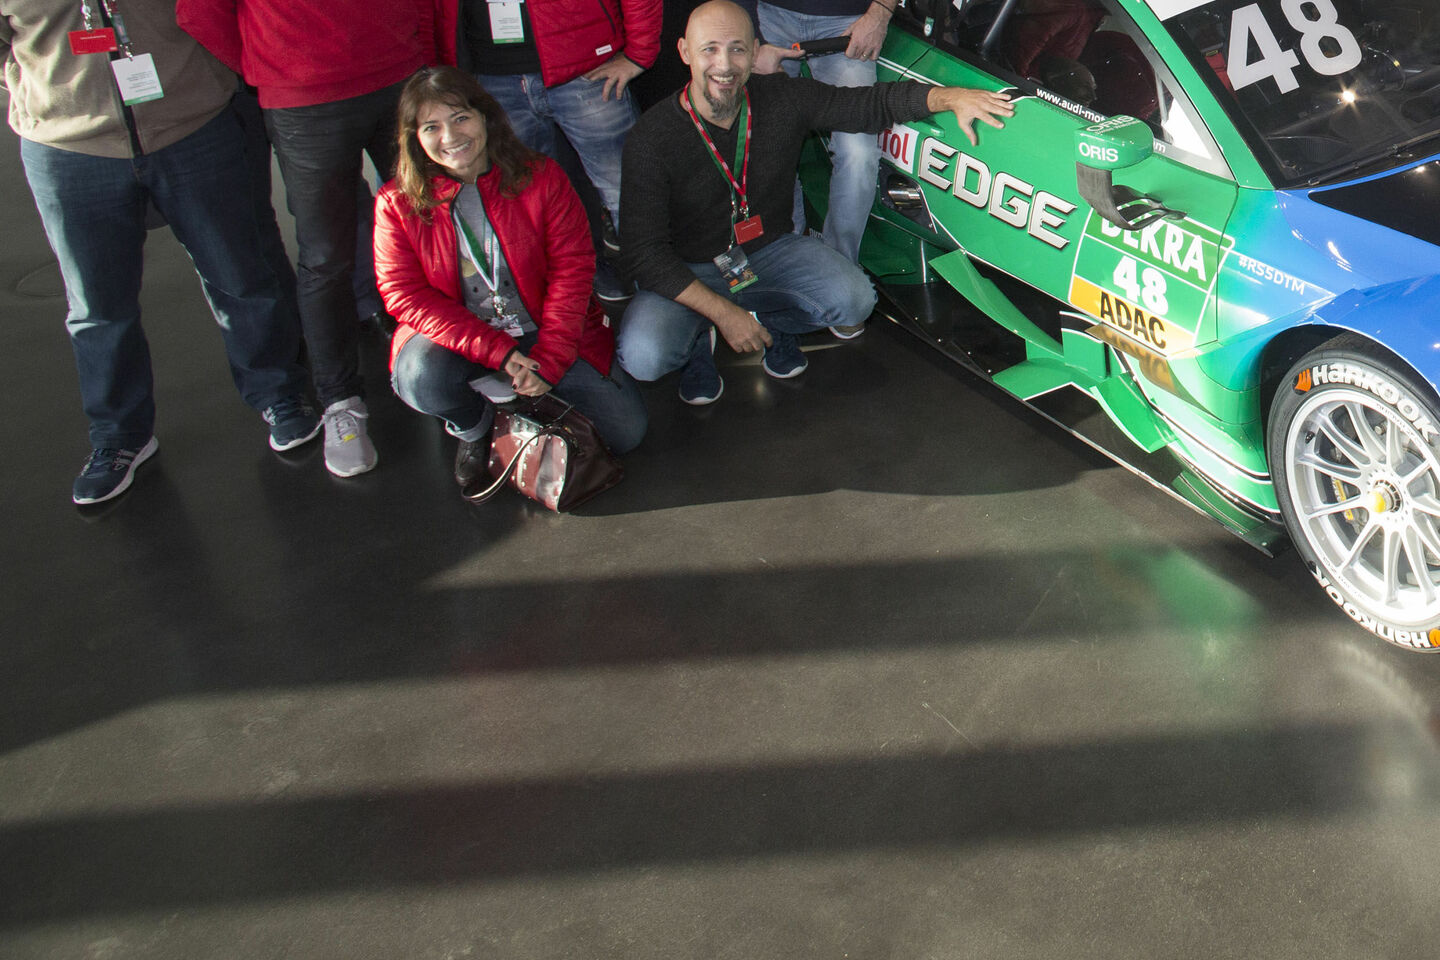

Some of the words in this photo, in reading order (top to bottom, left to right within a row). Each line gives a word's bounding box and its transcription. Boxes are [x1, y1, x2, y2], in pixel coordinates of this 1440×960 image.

[1086, 115, 1134, 132] ORIS
[1078, 142, 1118, 162] ORIS
[917, 136, 1078, 251] EDGE
[1113, 255, 1169, 316] 48
[1239, 255, 1306, 295] #RS5DTM
[1100, 291, 1166, 350] ADAC
